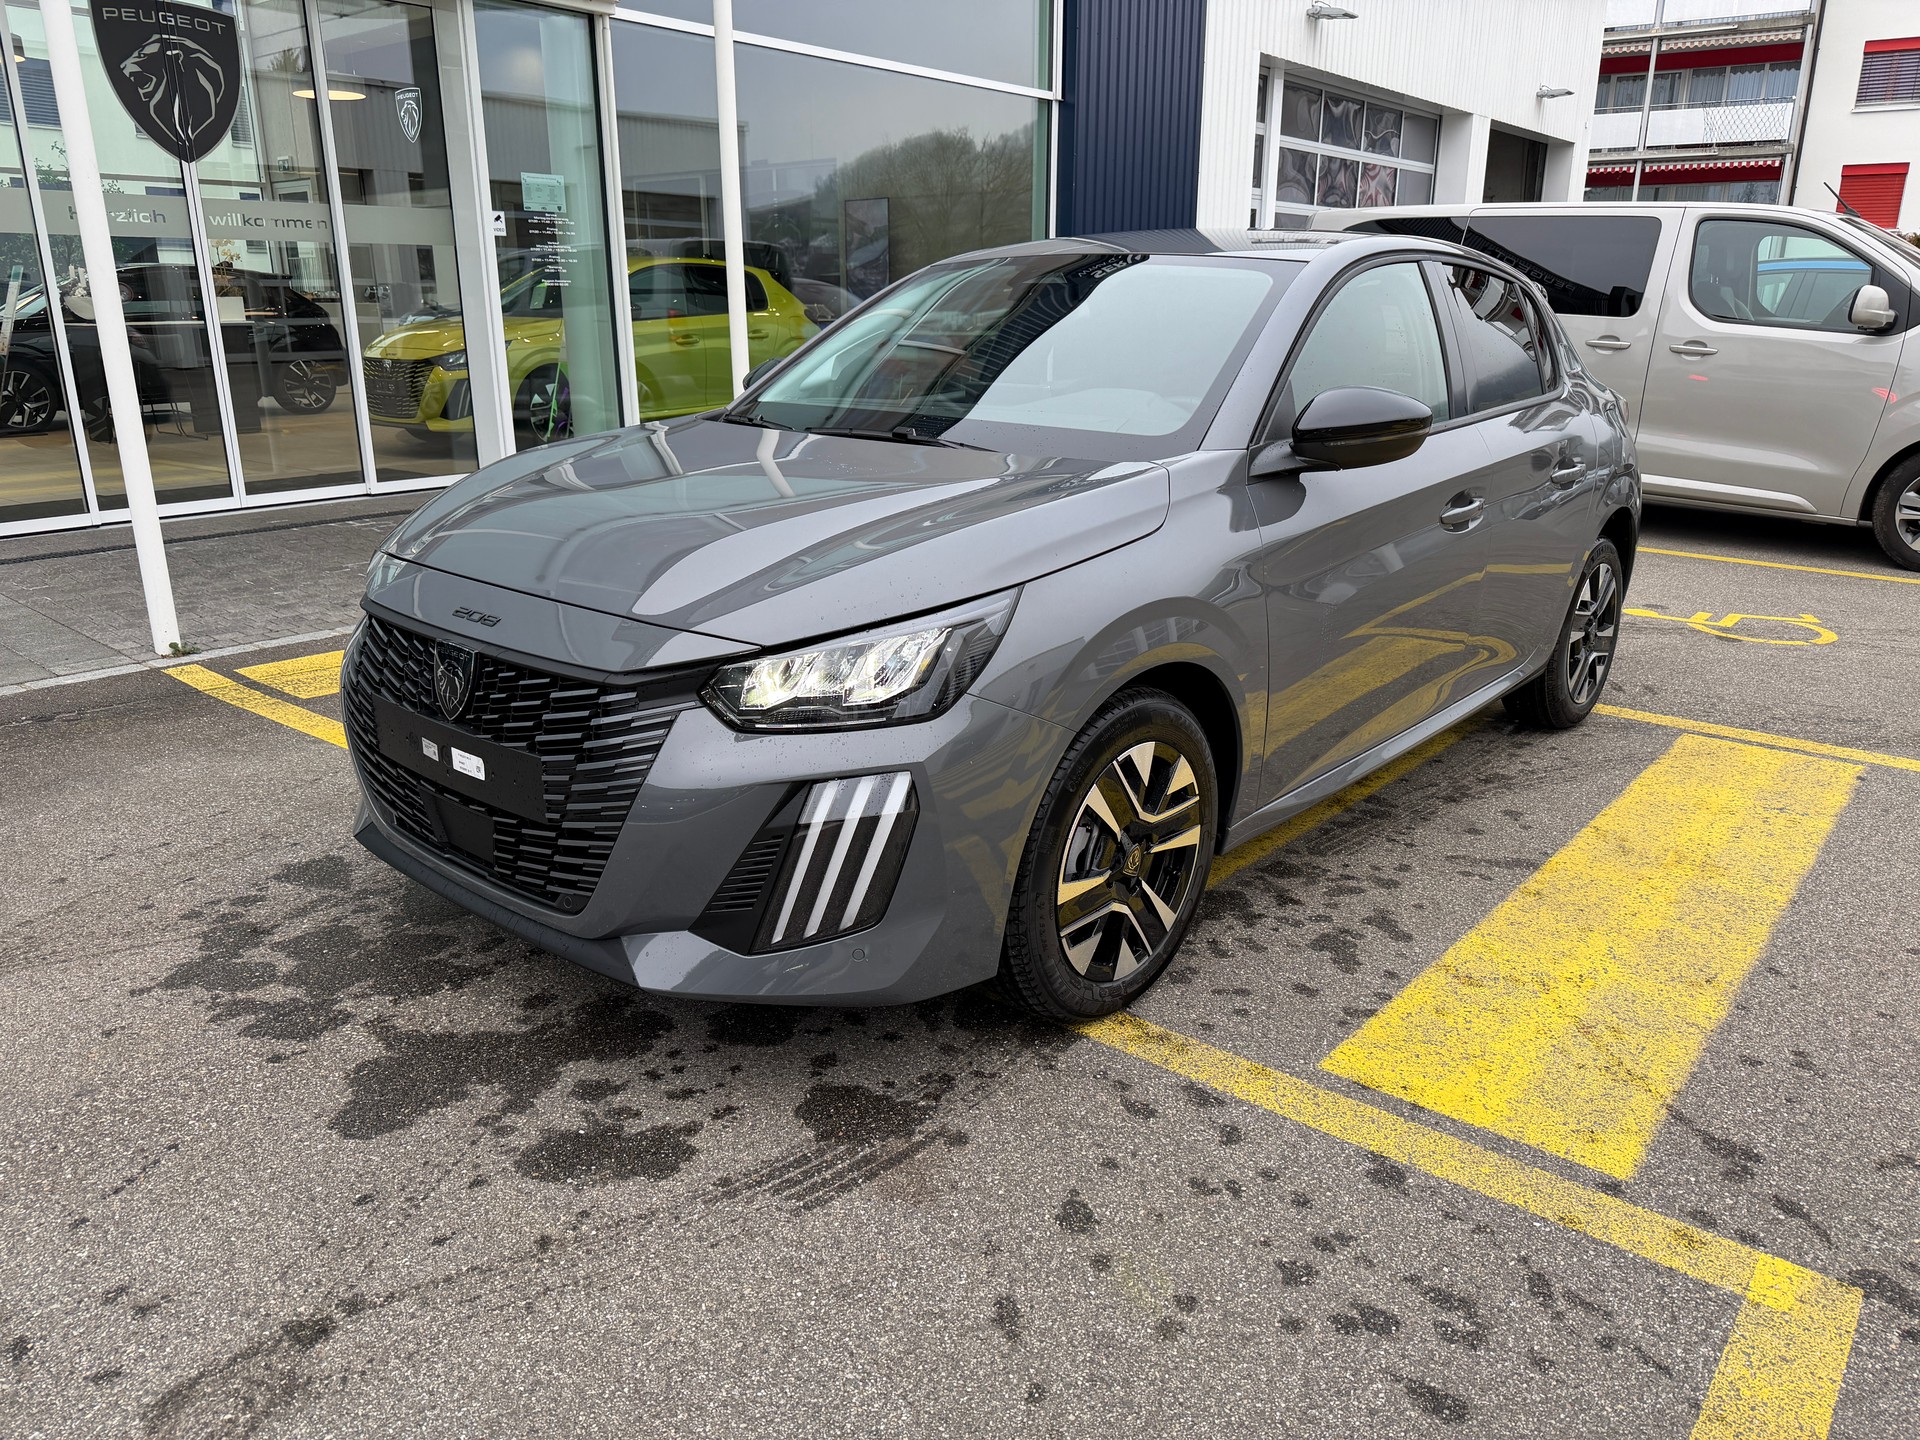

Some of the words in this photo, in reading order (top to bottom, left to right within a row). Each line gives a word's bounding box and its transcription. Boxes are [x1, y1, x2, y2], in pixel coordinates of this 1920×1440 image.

[102, 7, 226, 35] PEUGEOT
[397, 92, 418, 100] PEUGEOT
[452, 605, 502, 628] 208
